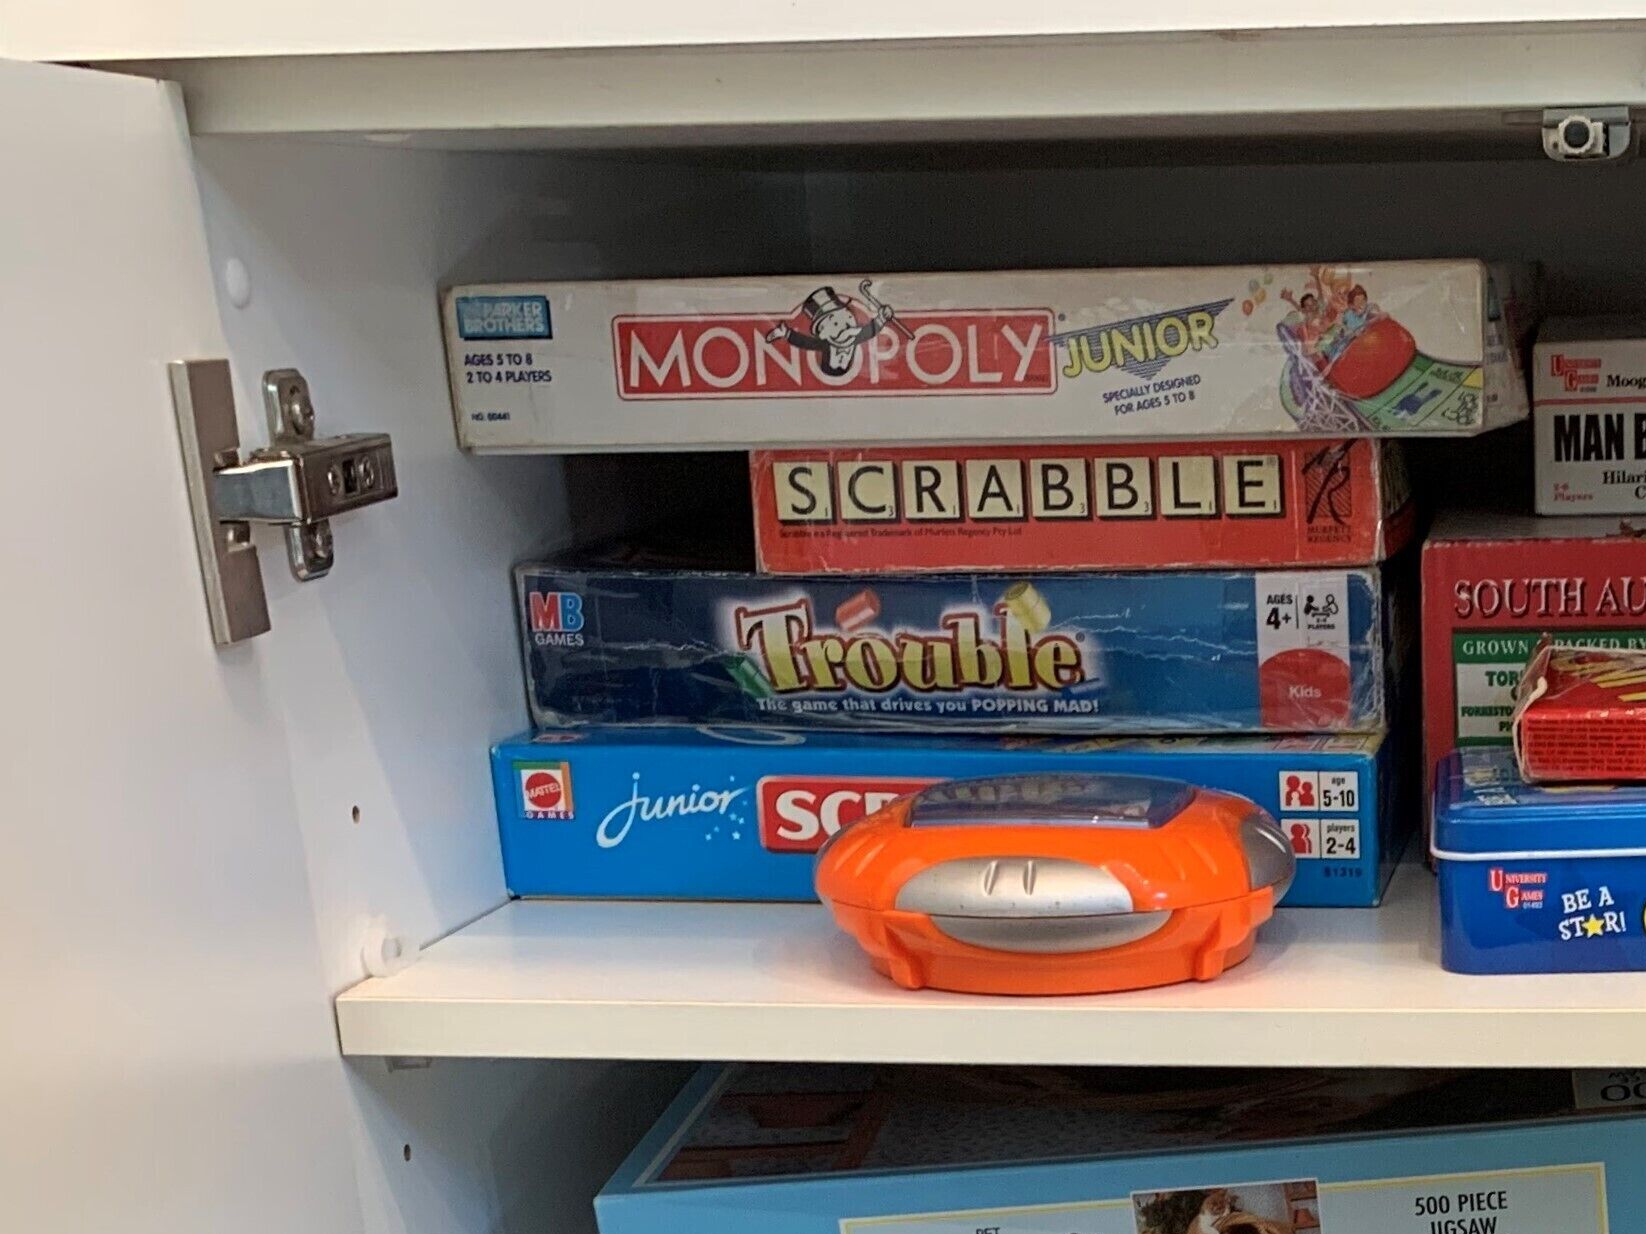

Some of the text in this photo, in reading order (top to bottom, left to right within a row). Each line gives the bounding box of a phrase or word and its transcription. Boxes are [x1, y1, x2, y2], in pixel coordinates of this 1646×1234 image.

[629, 322, 1044, 389] MONOPOLY
[1062, 310, 1219, 379] JUNIOR
[464, 353, 522, 366] AGES TO
[477, 370, 553, 383] TO PLAYERS
[1102, 374, 1201, 404] SPECIALLY DESIGNED
[1114, 391, 1187, 416] FOR AGES TO
[1553, 413, 1625, 462] MAN
[787, 459, 1268, 516] SCRABBLE
[1266, 593, 1293, 605] AGES
[1454, 574, 1594, 618] SOUTH
[529, 592, 585, 633] MB
[1266, 607, 1292, 630] 4+
[534, 632, 585, 647] GAMES
[734, 596, 1084, 697] Trouble
[1462, 639, 1529, 655] GROWN
[1288, 685, 1322, 699] Kids
[757, 698, 1100, 715] The game that drives you POPPING MAD!
[1331, 776, 1346, 786] age
[1323, 789, 1355, 808] 5-10
[1326, 822, 1356, 834] players
[1326, 837, 1356, 855] 2-4
[1561, 885, 1615, 914] BE A
[1414, 1190, 1509, 1217] 500 PIECE
